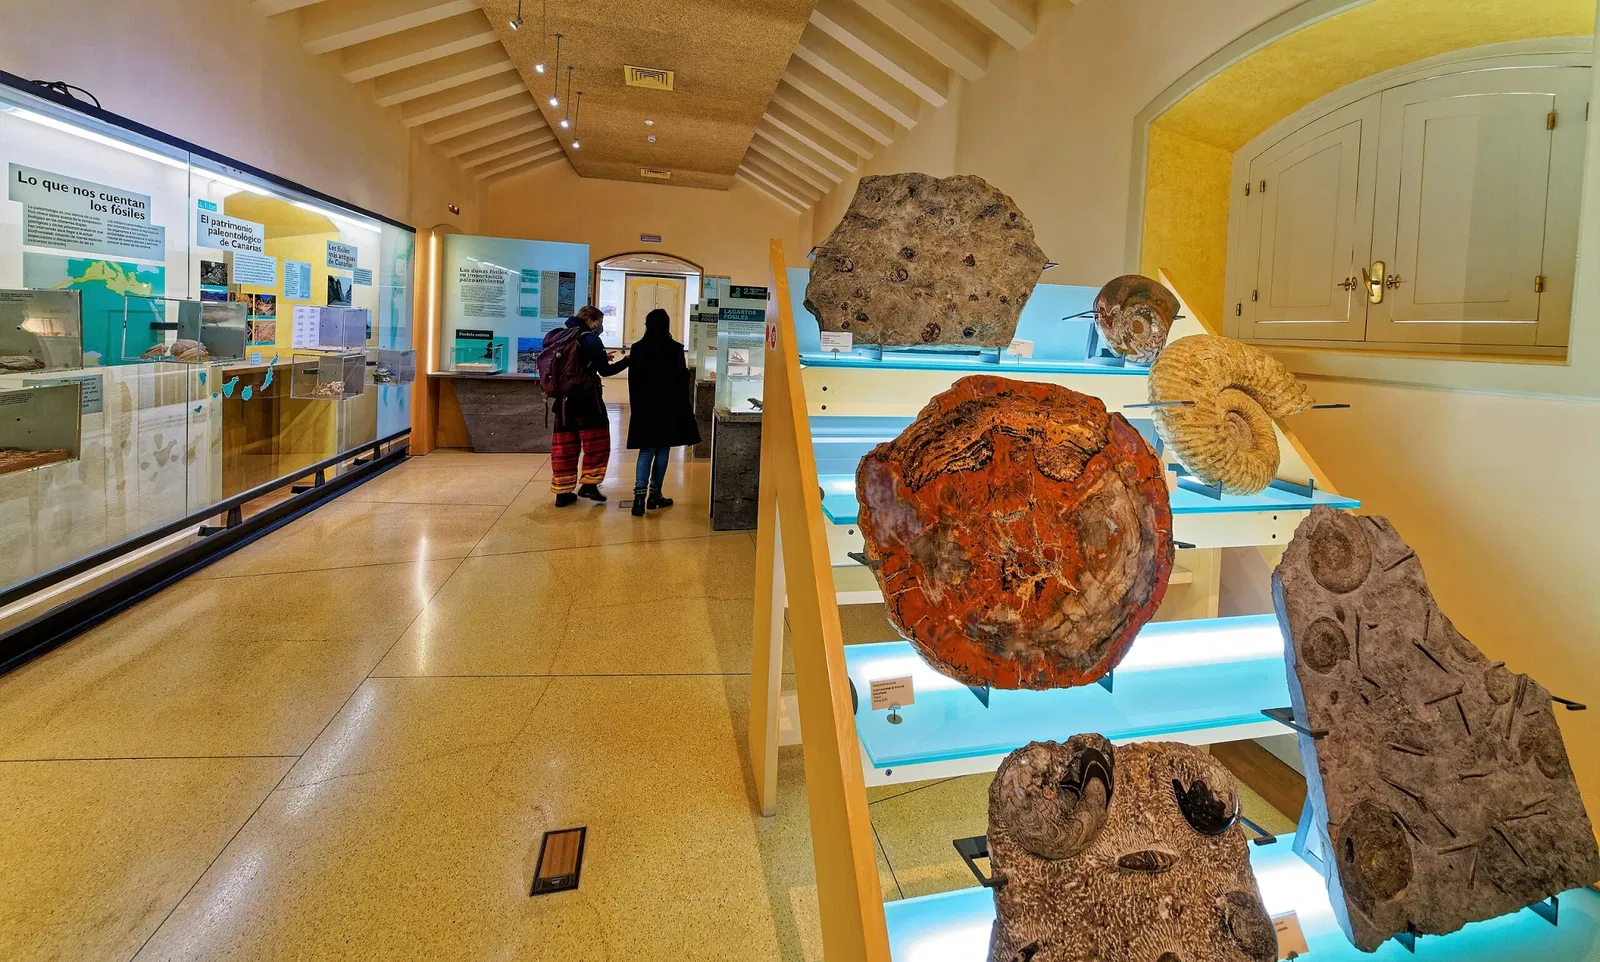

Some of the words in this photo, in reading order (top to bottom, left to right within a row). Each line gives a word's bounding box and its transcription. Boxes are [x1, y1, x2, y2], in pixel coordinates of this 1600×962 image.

[18, 171, 37, 185] Lo
[43, 179, 68, 192] que
[74, 187, 95, 198] nos
[100, 193, 145, 209] cuentan
[91, 200, 107, 213] los
[111, 204, 145, 220] fósiles
[201, 215, 208, 224] El
[212, 219, 252, 233] patrimonio
[208, 228, 261, 244] paleontológico
[220, 238, 229, 247] de
[232, 240, 261, 252] Canarias
